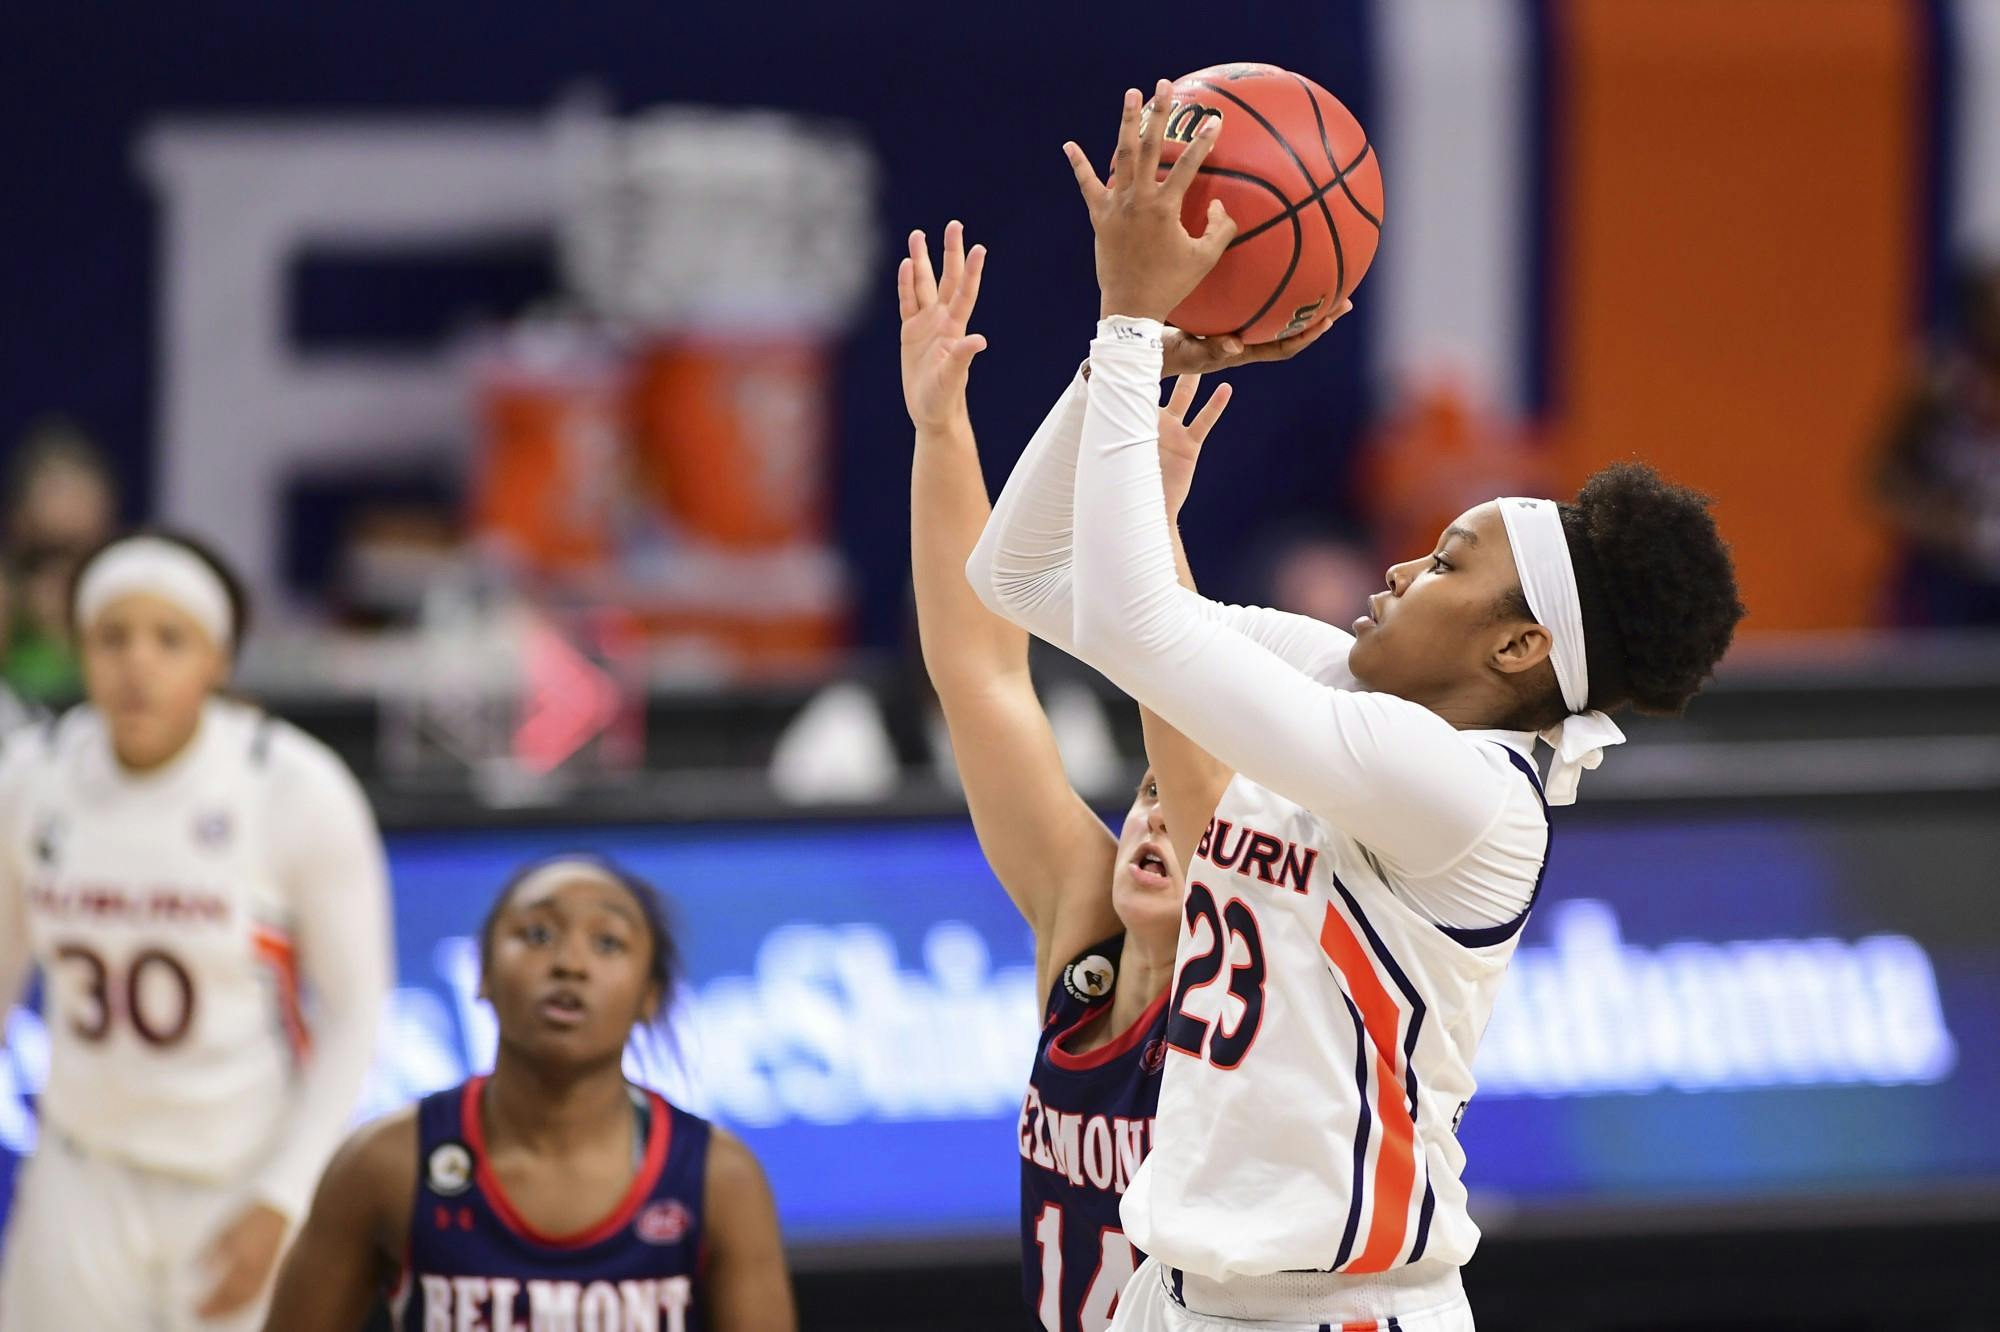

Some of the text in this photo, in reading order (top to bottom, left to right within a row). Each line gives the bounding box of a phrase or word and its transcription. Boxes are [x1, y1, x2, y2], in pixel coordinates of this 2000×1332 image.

[54, 942, 198, 1050] 30
[1166, 880, 1267, 1071] 23
[1017, 1083, 1157, 1196] ELMON
[419, 1273, 692, 1332] BELMONT
